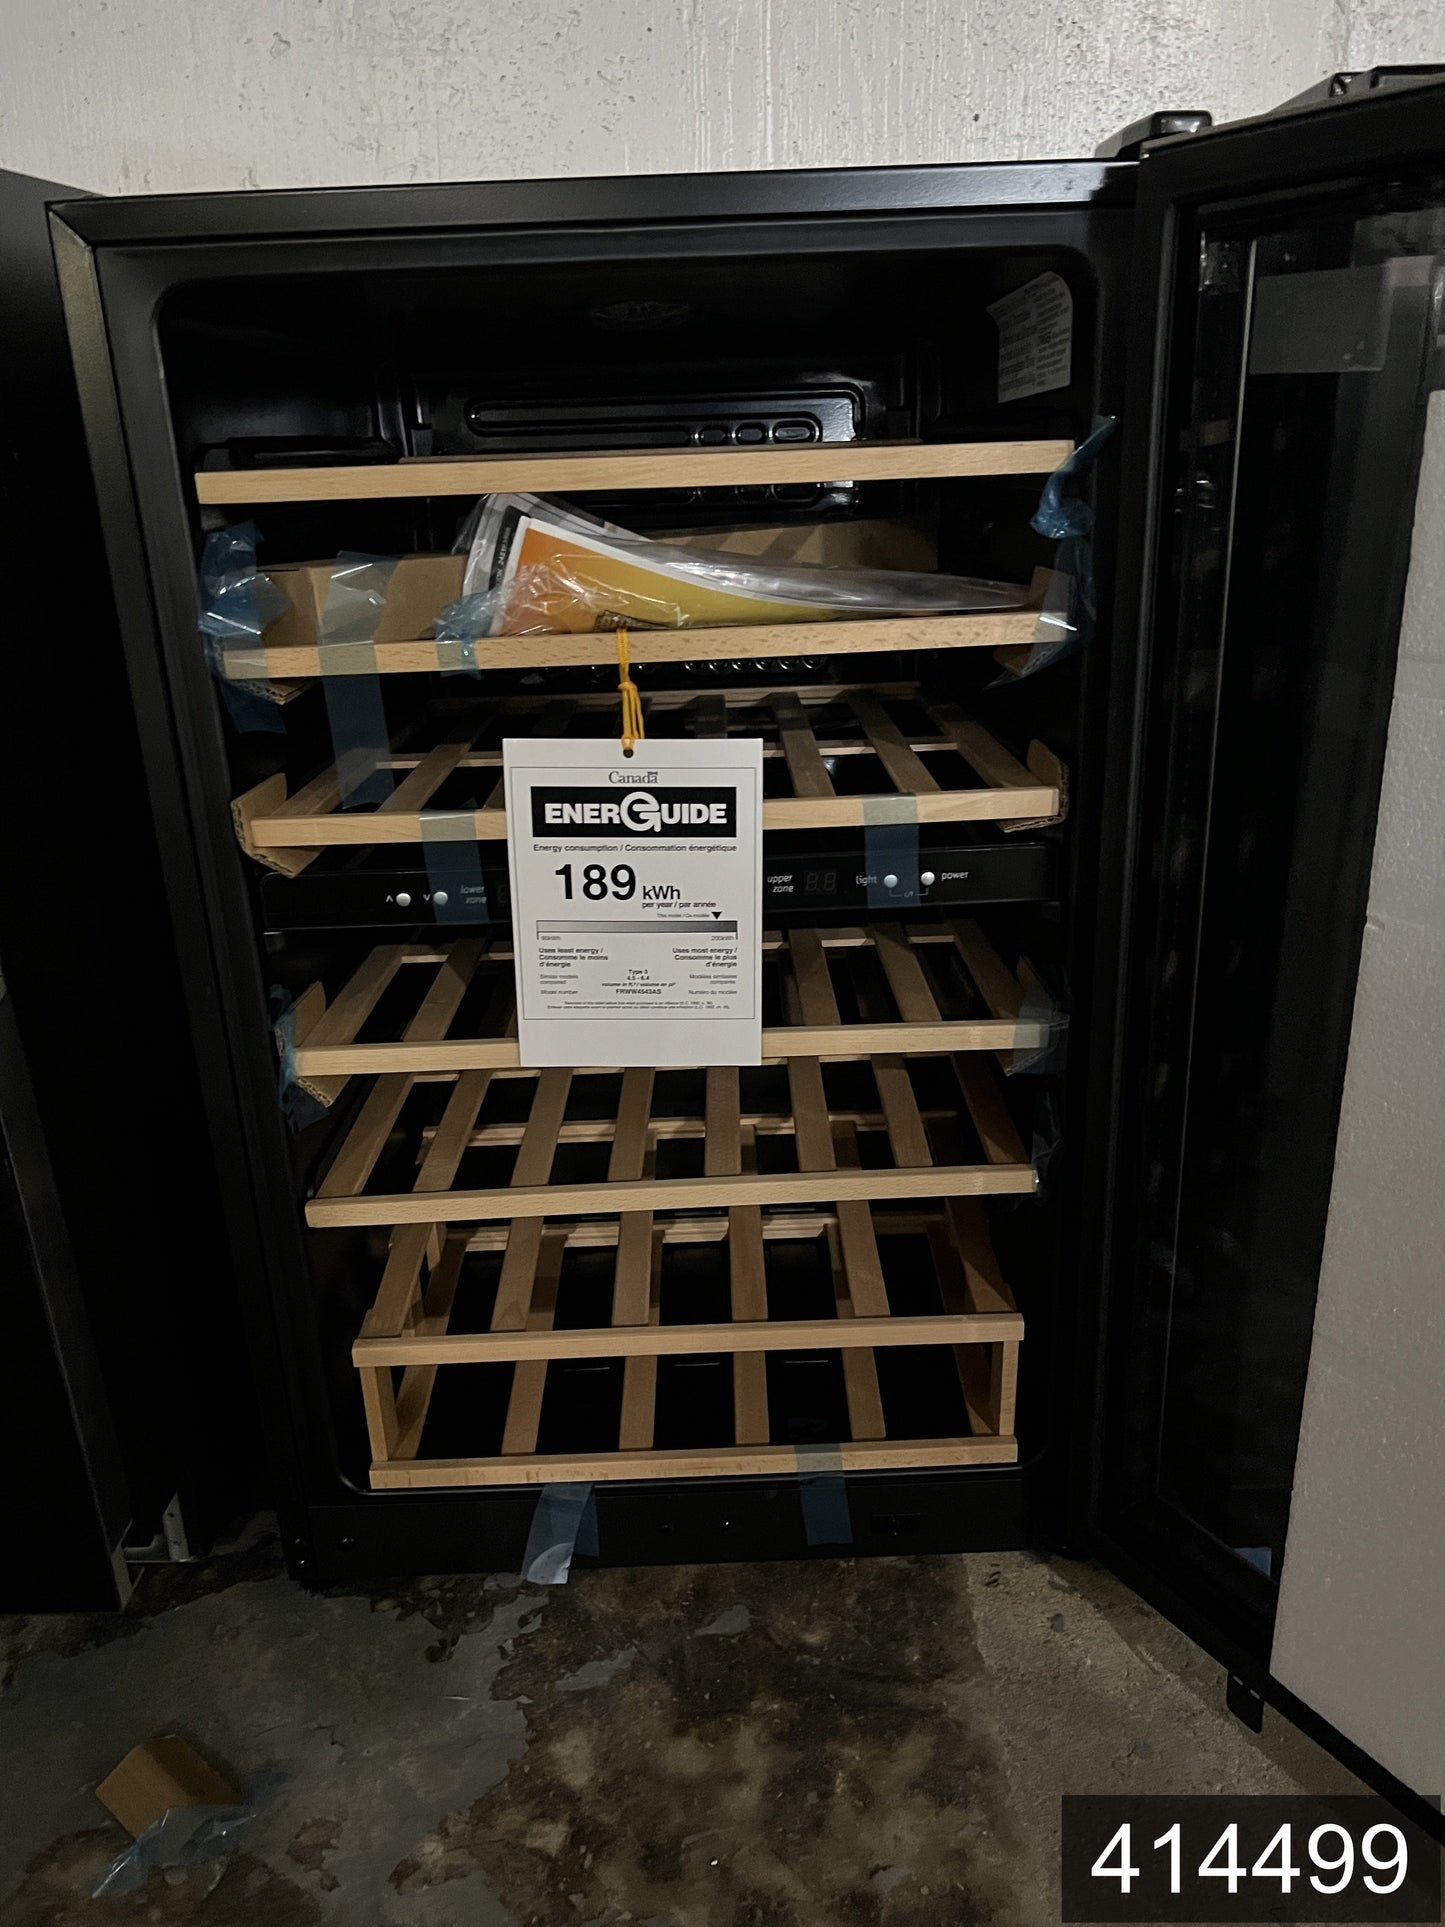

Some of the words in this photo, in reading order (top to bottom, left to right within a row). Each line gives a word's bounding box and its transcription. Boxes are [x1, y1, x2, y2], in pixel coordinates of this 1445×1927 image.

[608, 771, 658, 784] Canada
[544, 791, 727, 832] ENERGUIDE
[533, 844, 562, 853] Energy
[564, 844, 618, 853] consumption
[625, 844, 687, 852] Consommation
[689, 843, 737, 853] énergétique
[555, 863, 636, 901] 189
[643, 885, 681, 900] kWh
[767, 874, 793, 884] upper
[856, 875, 878, 886] light
[941, 871, 969, 881] power
[460, 885, 485, 894] lower
[772, 885, 794, 893] zone
[642, 901, 657, 909] per
